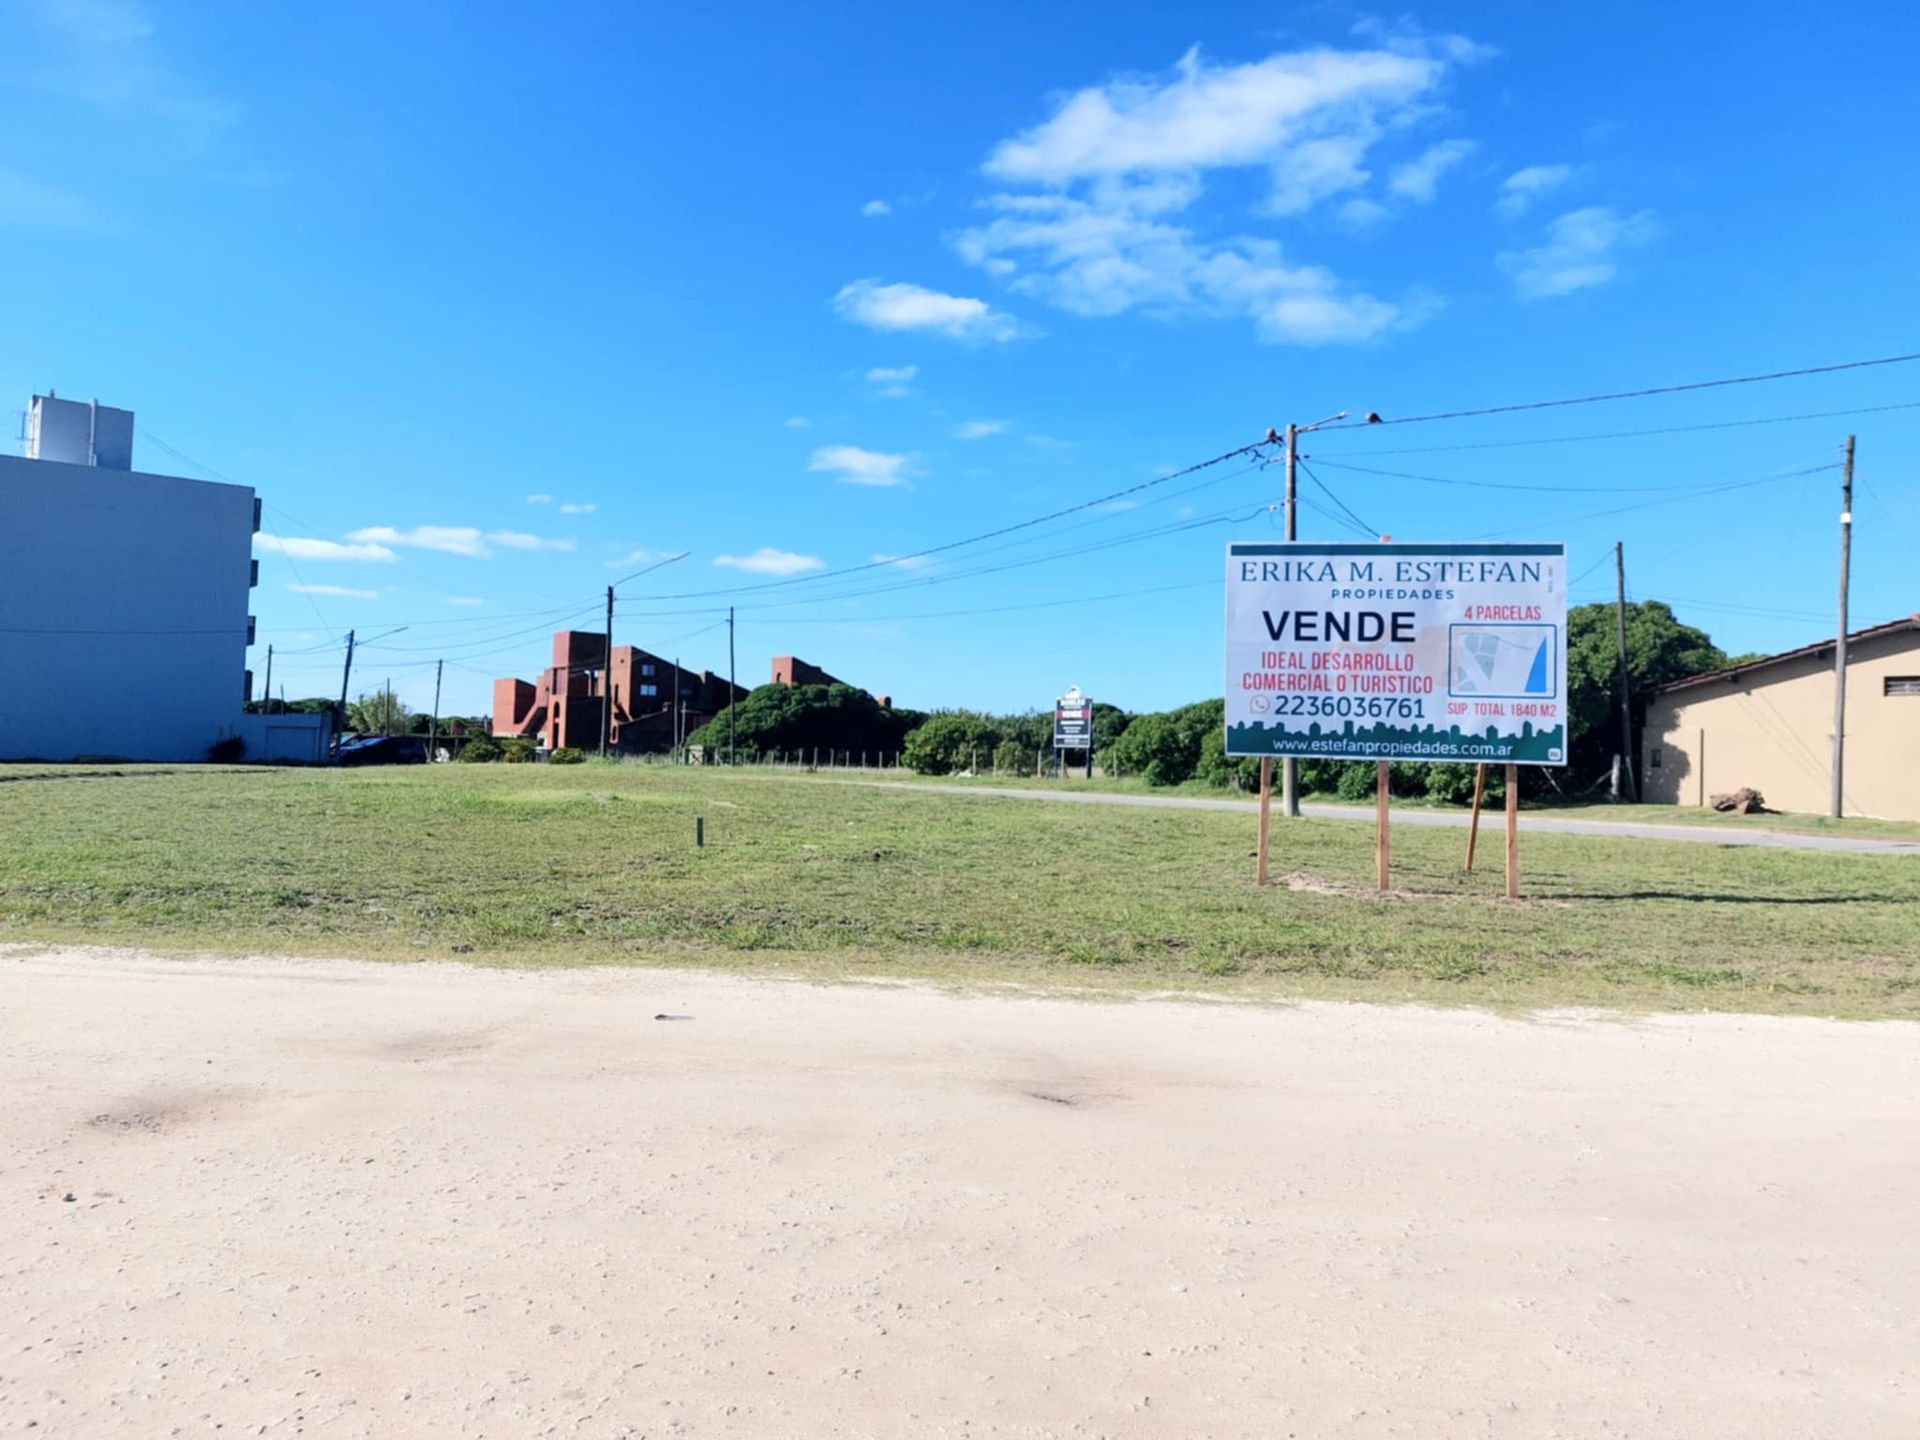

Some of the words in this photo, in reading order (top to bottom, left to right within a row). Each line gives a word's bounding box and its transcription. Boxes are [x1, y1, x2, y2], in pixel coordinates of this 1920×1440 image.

[1241, 561, 1337, 582] ERIKA
[1350, 561, 1383, 582] M.
[1395, 561, 1541, 583] ESTEFAN
[1331, 588, 1455, 600] PROPIEDADES
[1464, 605, 1473, 620] 4
[1476, 605, 1542, 621] PARCELAS
[1262, 610, 1416, 643] VENDE
[1261, 652, 1307, 669] IDEAL
[1311, 652, 1414, 672] DESARROLLO
[1242, 672, 1332, 692] COMERCIAL
[1336, 674, 1346, 693] O
[1351, 674, 1433, 694] TURISTICO
[1274, 694, 1425, 719] 2236036761
[1474, 702, 1506, 717] TOTAL
[1539, 704, 1557, 718] M2
[1272, 738, 1514, 757] www.estefanpropiedades.com.ar
